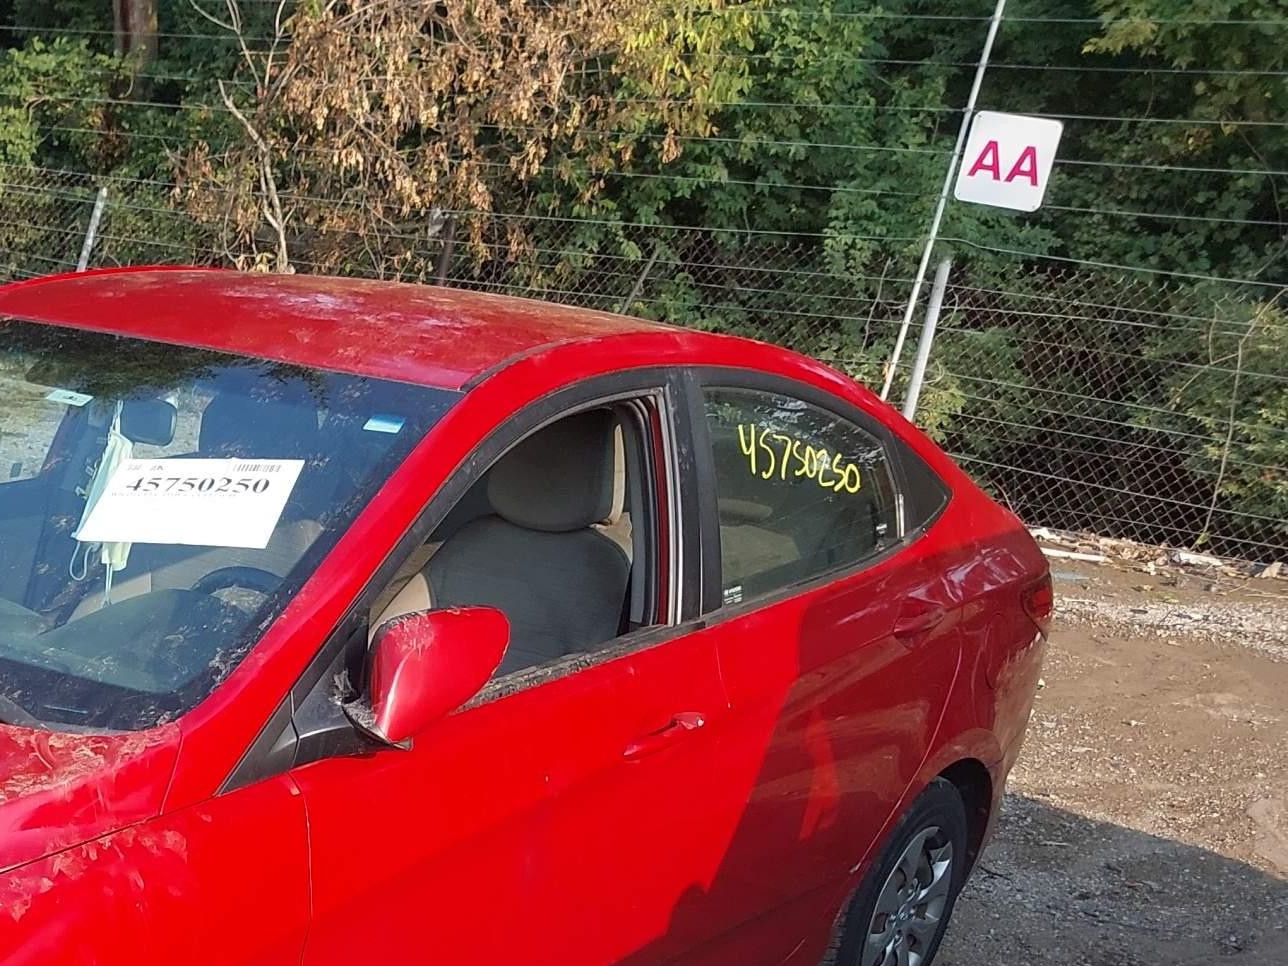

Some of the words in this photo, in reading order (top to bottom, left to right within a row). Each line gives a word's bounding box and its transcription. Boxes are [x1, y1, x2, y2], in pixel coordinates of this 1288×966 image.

[967, 140, 1039, 187] AA
[738, 423, 861, 494] 45750250
[126, 477, 270, 494] 45750250
